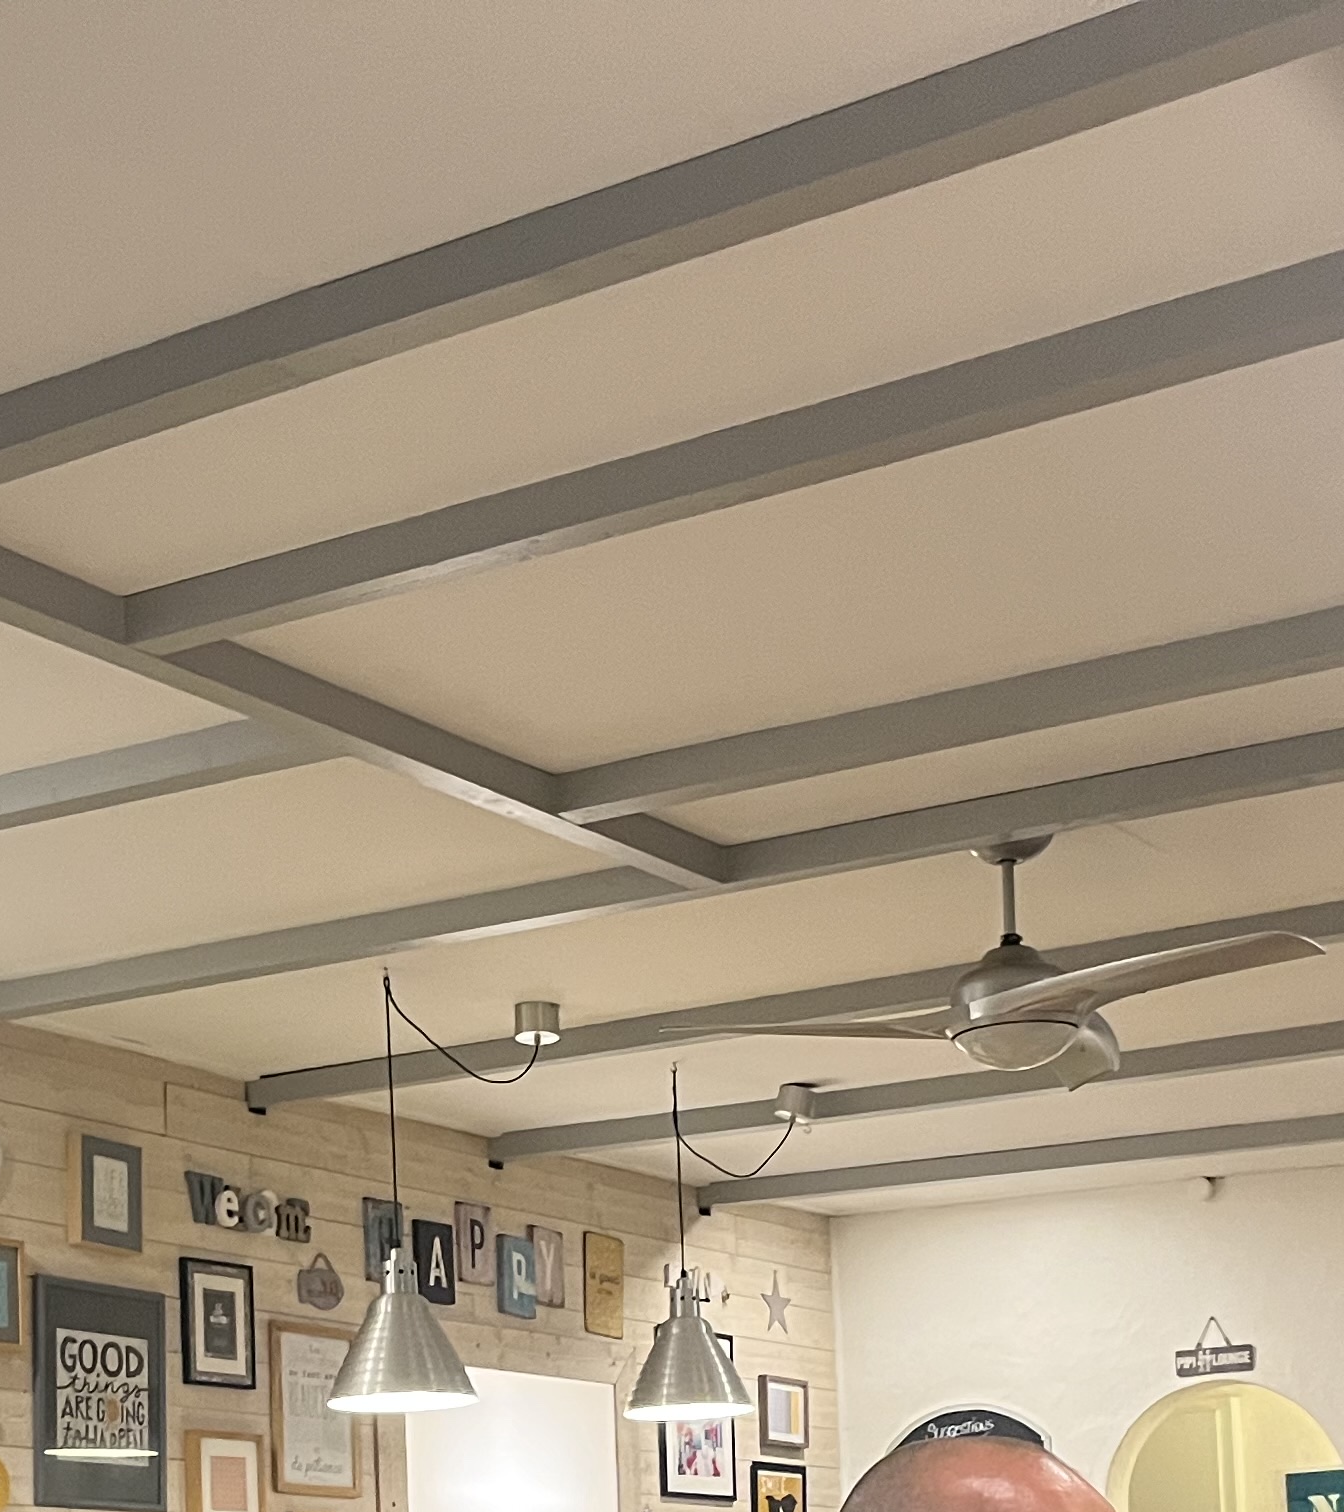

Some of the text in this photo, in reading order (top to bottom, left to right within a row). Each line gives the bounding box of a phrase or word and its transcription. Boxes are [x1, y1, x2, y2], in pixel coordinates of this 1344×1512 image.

[59, 1335, 145, 1378] GOOD
[57, 1372, 149, 1403] things
[60, 1395, 93, 1421] ARE
